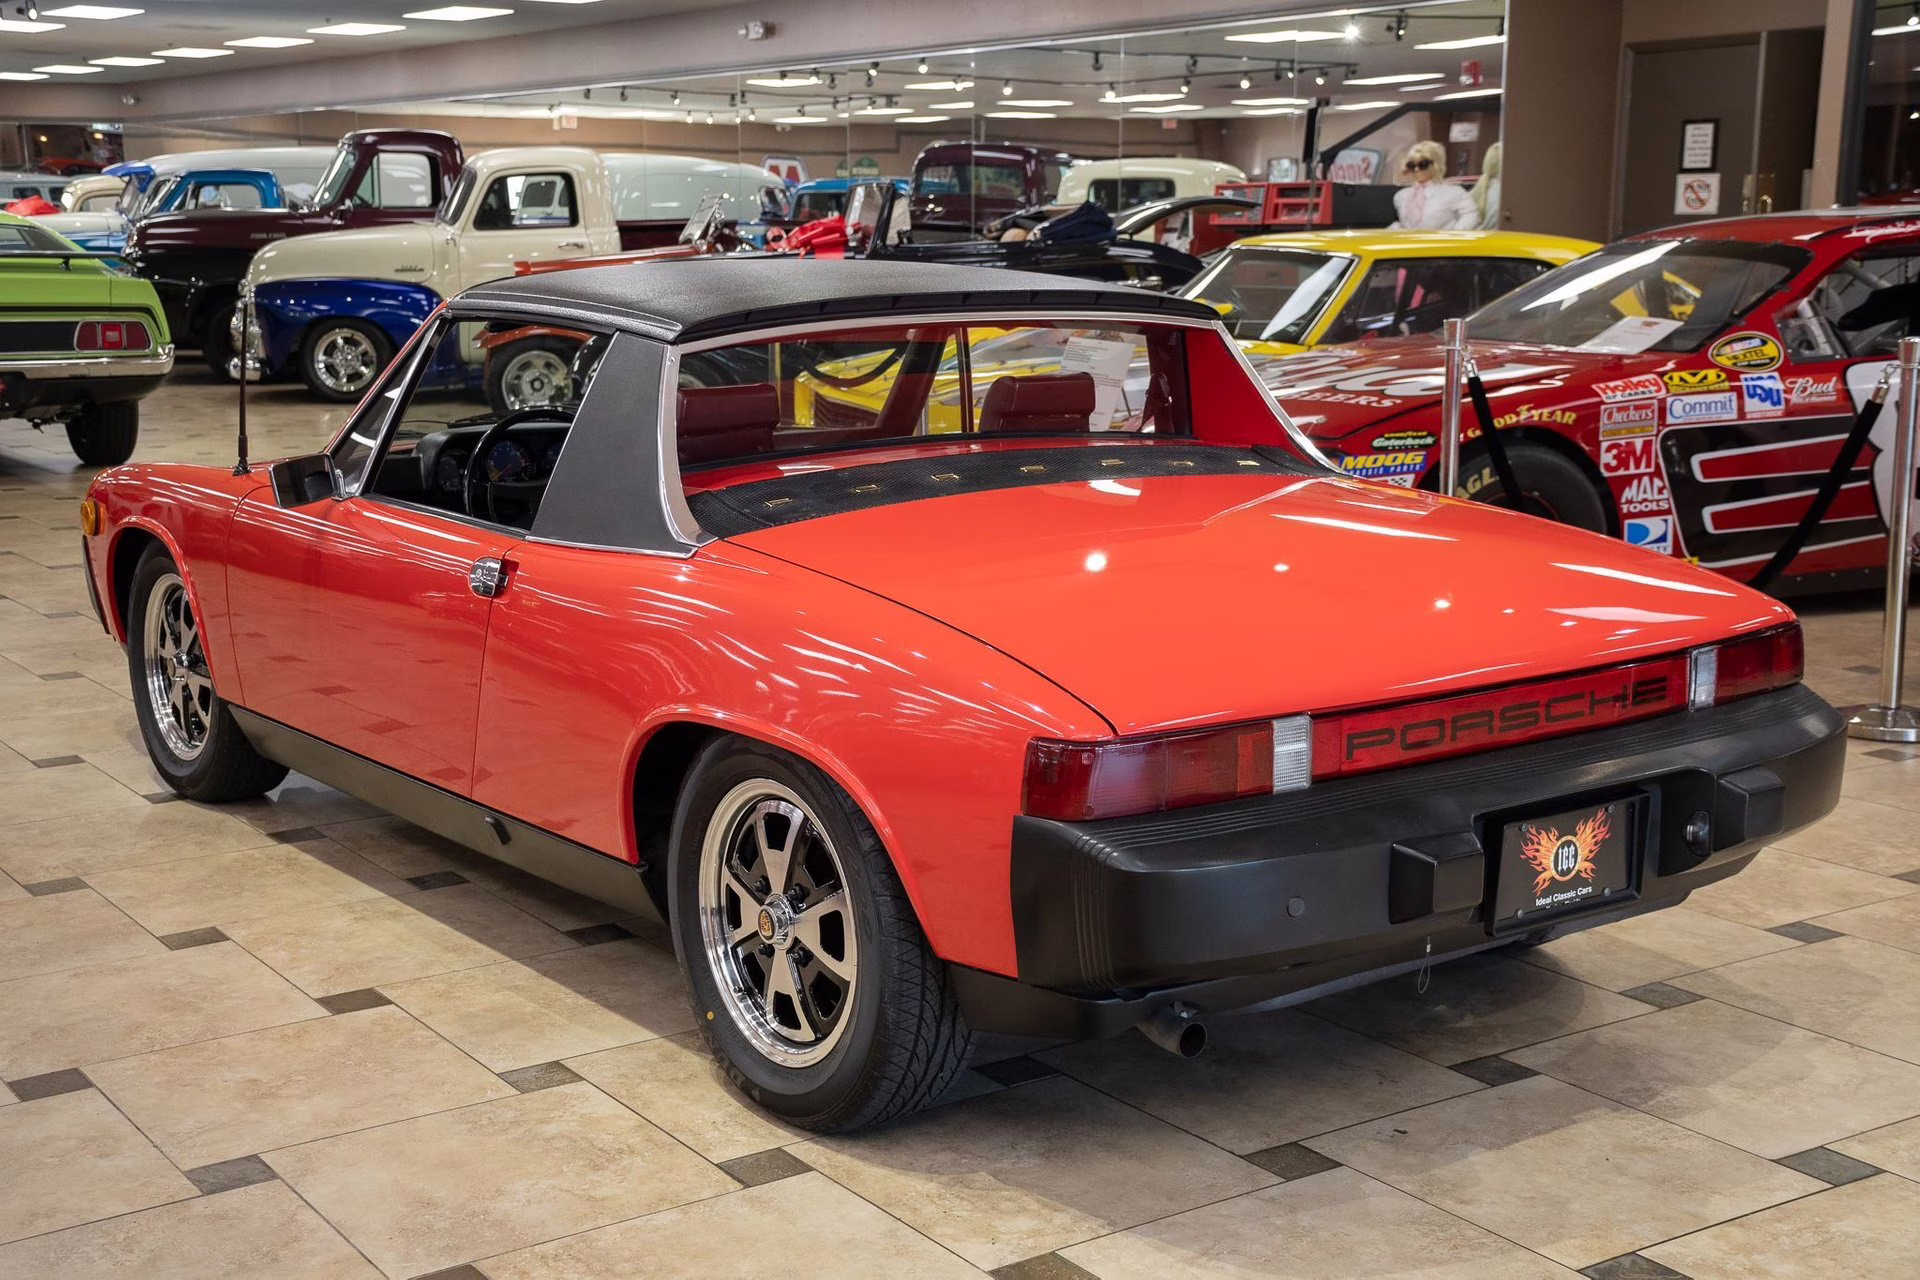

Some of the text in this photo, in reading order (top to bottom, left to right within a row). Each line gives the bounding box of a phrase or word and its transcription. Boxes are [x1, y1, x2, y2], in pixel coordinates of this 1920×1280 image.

[1600, 378, 1663, 395] Holley
[1785, 376, 1837, 399] Bud
[1670, 394, 1735, 419] Commit
[1341, 452, 1427, 471] MOOG
[1603, 439, 1653, 473] 3M
[1621, 476, 1669, 503] MAC
[1621, 500, 1670, 513] TOOLS
[1346, 676, 1668, 761] PORSCHE
[1535, 896, 1552, 906] Ideal
[1553, 890, 1577, 902] Classic
[1577, 886, 1593, 896] Cars
